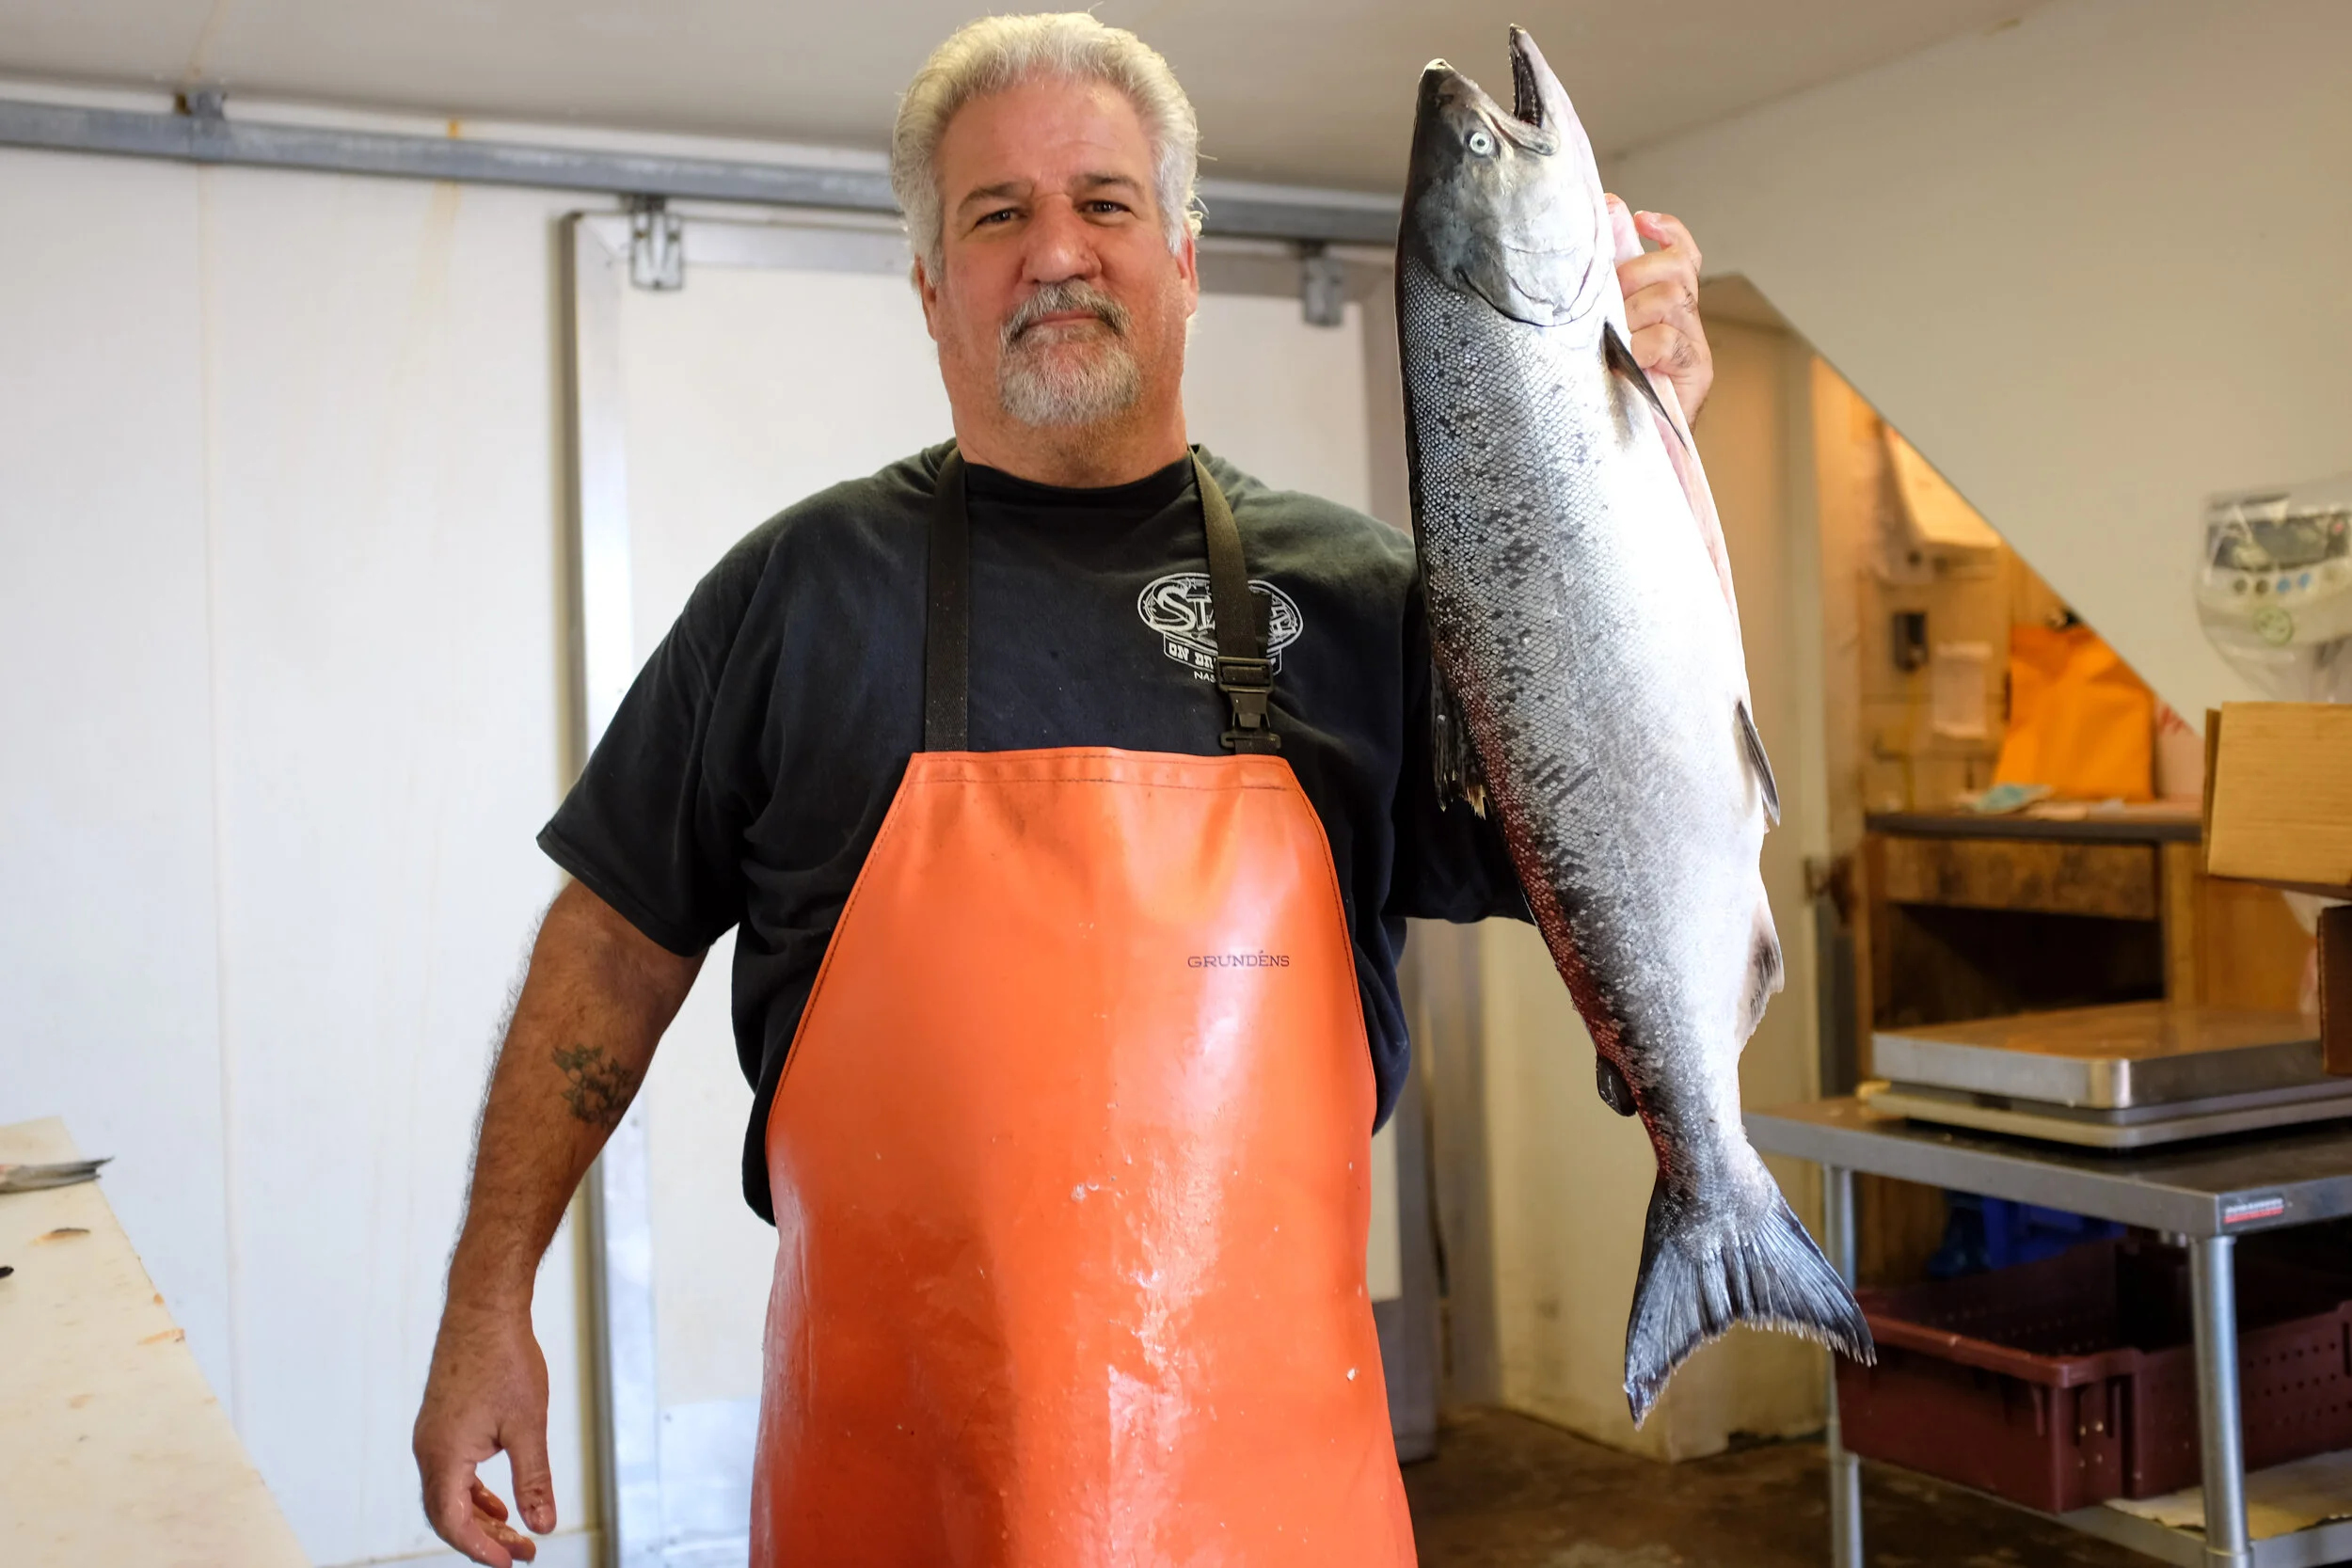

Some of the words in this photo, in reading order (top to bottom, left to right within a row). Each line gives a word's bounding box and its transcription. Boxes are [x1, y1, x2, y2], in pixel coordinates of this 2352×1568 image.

[1168, 641, 1189, 661] ON
[1194, 651, 1216, 670] DR
[1194, 670, 1216, 683] NAS
[1187, 949, 1290, 968] GRUNDÉNS
